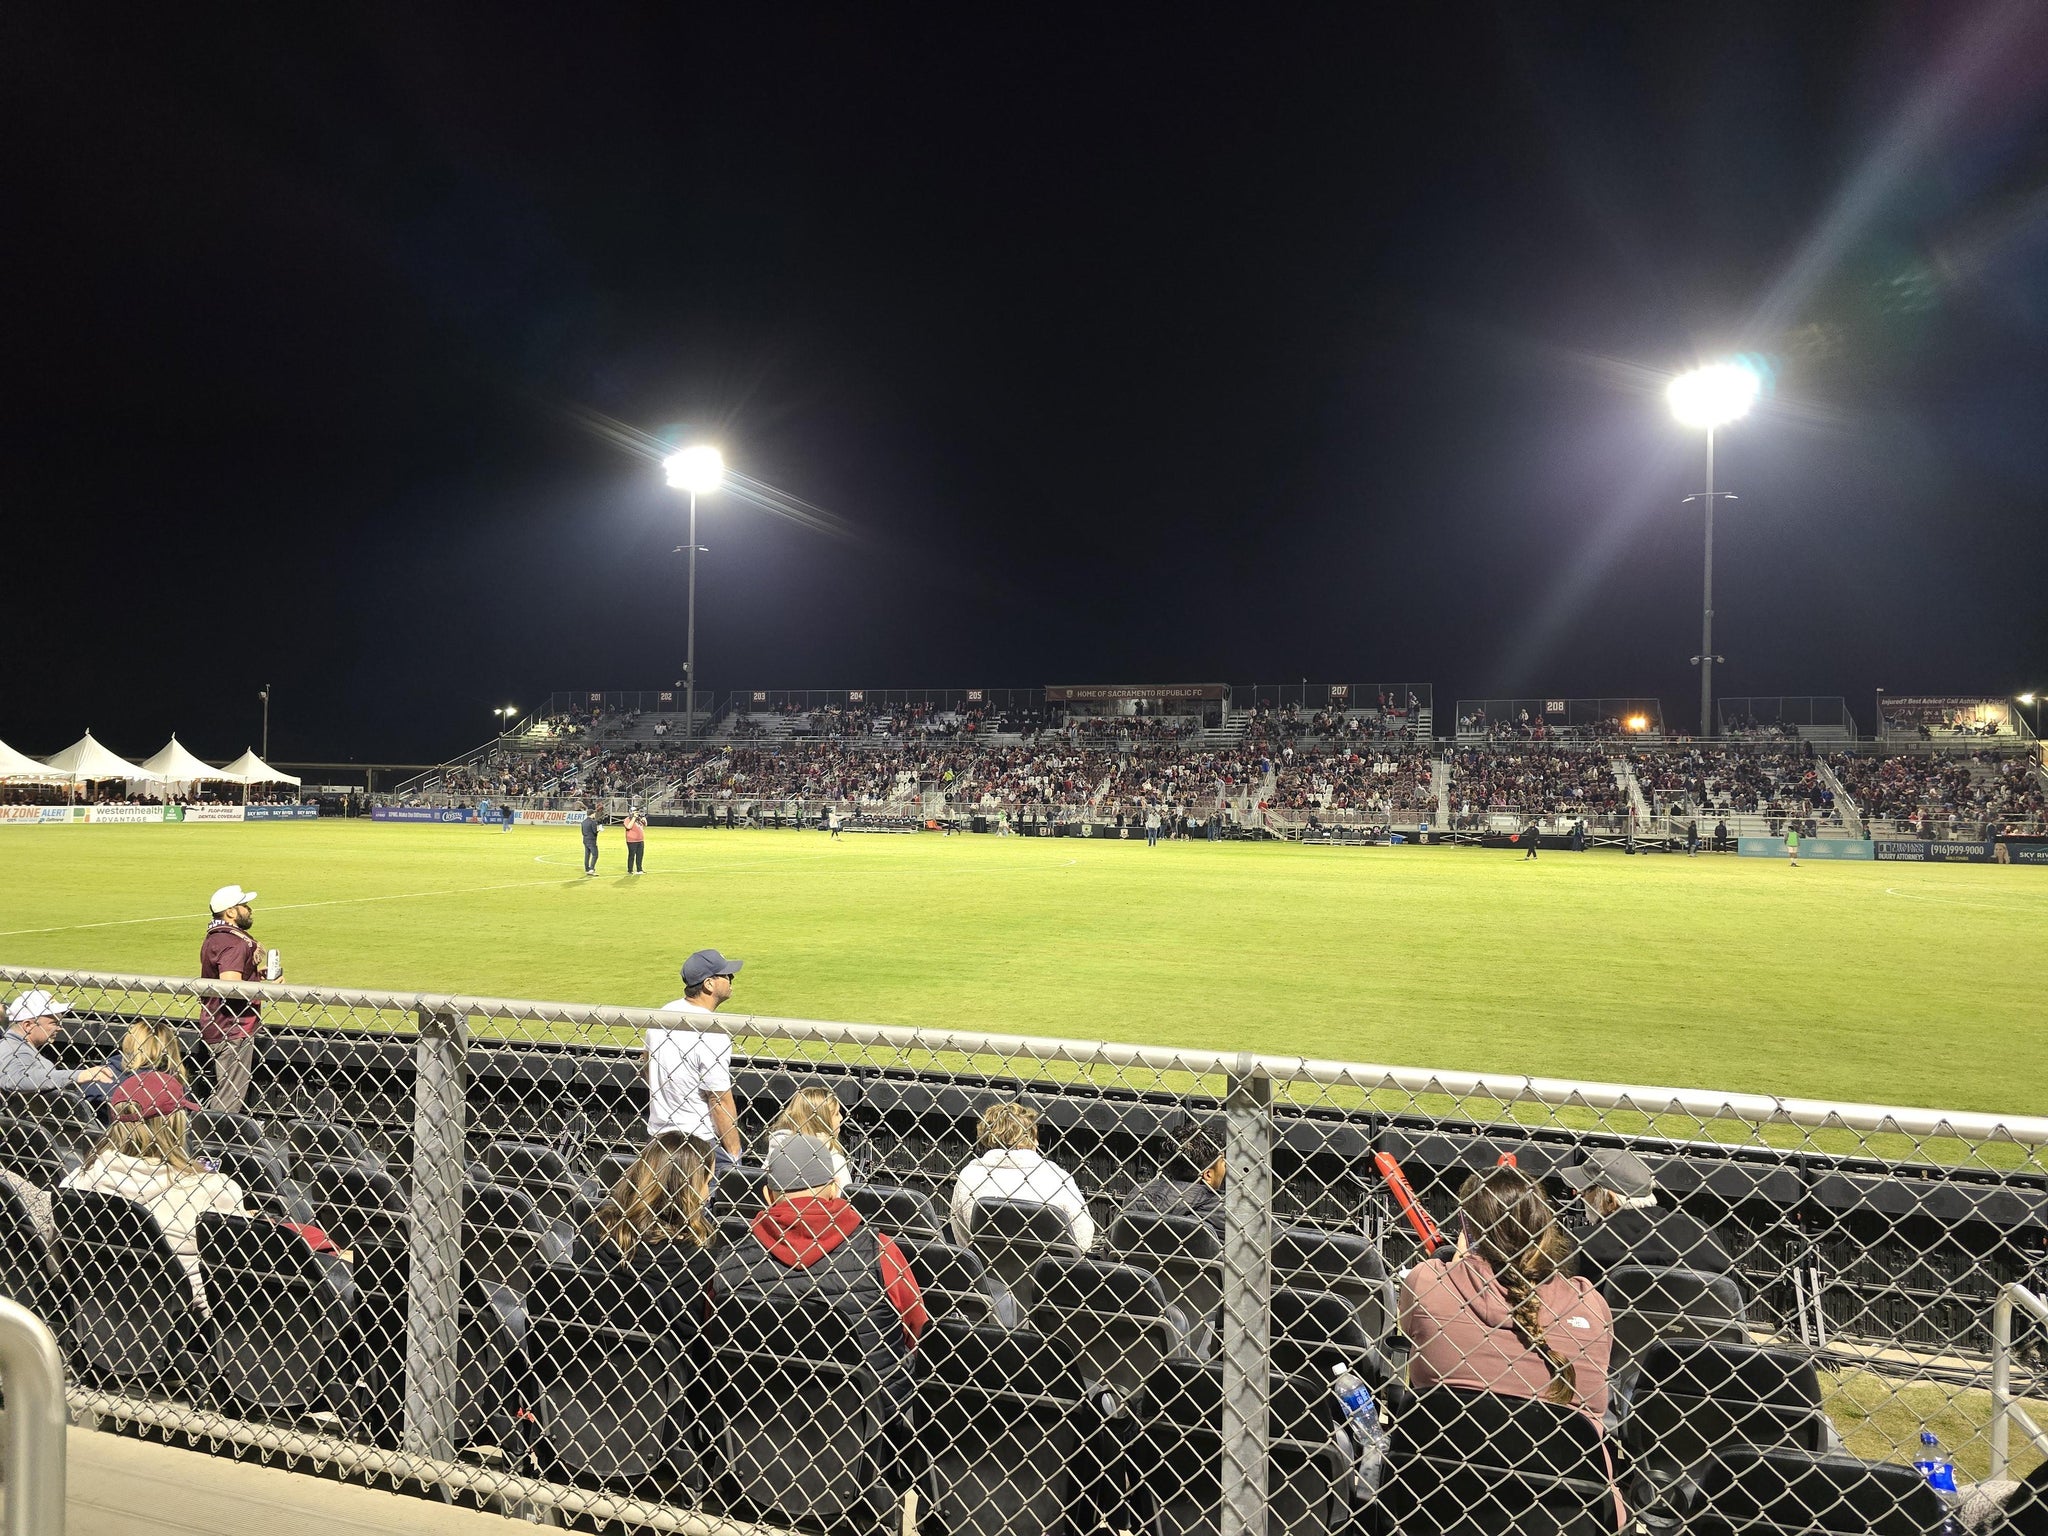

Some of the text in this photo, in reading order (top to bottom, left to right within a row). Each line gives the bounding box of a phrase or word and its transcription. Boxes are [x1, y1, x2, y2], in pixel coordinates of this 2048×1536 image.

[1156, 689, 1192, 697] REPUBLIC
[1331, 686, 1347, 695] 207
[590, 693, 601, 701] 201
[660, 692, 672, 701] 202
[753, 692, 766, 700] 203
[850, 692, 863, 700] 204
[968, 691, 982, 700] 205
[1547, 701, 1564, 711] 208
[1881, 697, 1907, 706] Injured?
[12, 807, 41, 818] ZONE
[41, 808, 67, 817] ALERT
[96, 806, 163, 815] westernhealth
[522, 811, 546, 820] WORK
[546, 811, 567, 821] ZONE
[1930, 844, 1985, 856] (916)999-9000
[1896, 853, 1925, 861] ATTORNEYS
